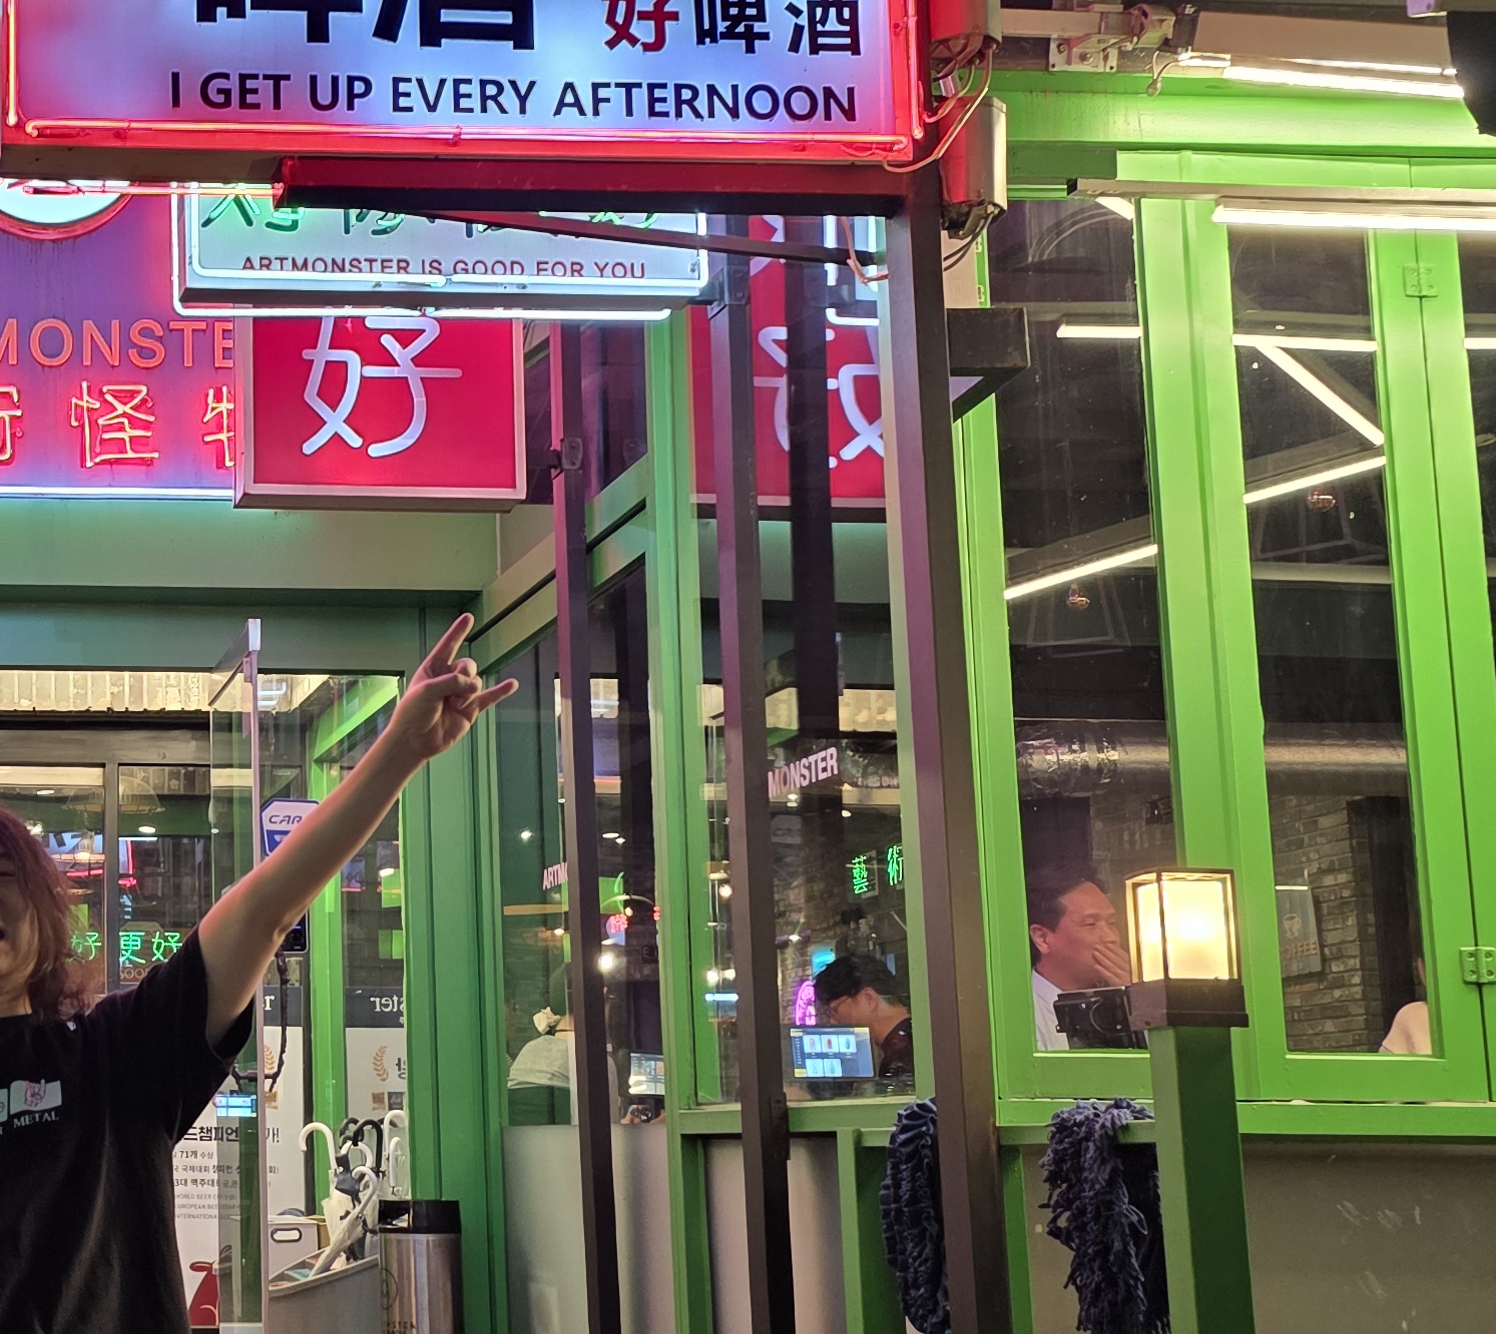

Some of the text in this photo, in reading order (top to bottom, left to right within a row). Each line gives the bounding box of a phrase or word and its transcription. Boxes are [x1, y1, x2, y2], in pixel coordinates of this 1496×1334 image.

[170, 71, 857, 123] I GET UP EVERY AFTERNOON
[241, 256, 645, 280] ARTMONSTER IS GOOD FOR YOU
[301, 307, 462, 458] 好
[767, 746, 839, 798] MONSTER
[13, 1112, 59, 1128] METAL
